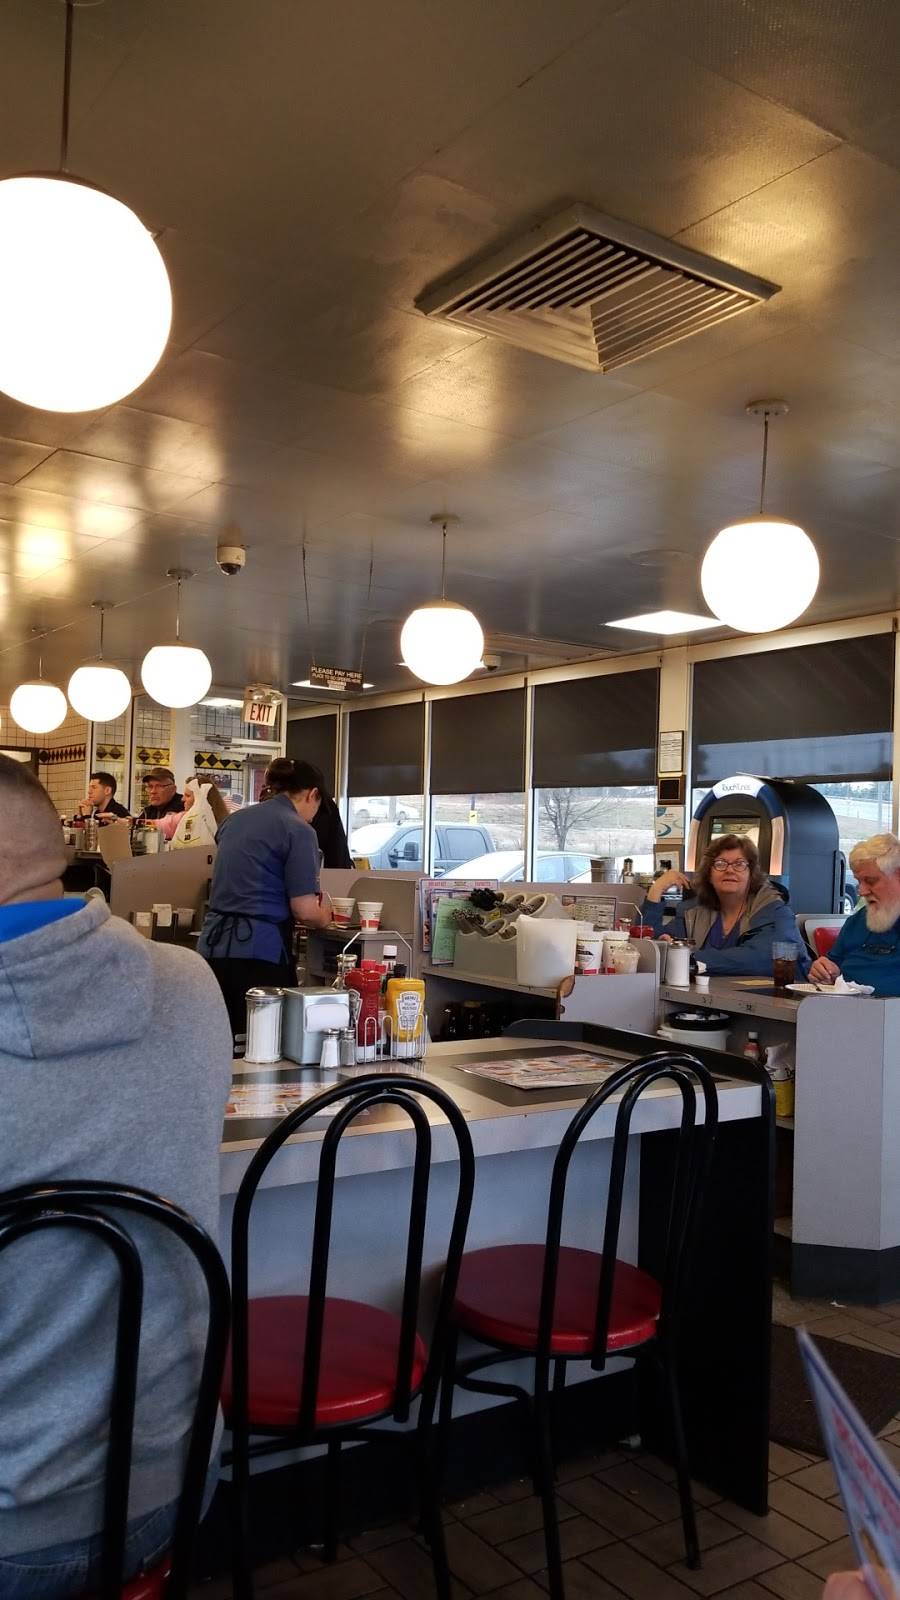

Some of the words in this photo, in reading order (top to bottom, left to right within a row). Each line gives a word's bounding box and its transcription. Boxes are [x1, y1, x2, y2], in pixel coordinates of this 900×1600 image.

[311, 666, 334, 676] PLEASE
[346, 672, 363, 680] HERE
[250, 703, 272, 722] EXIT
